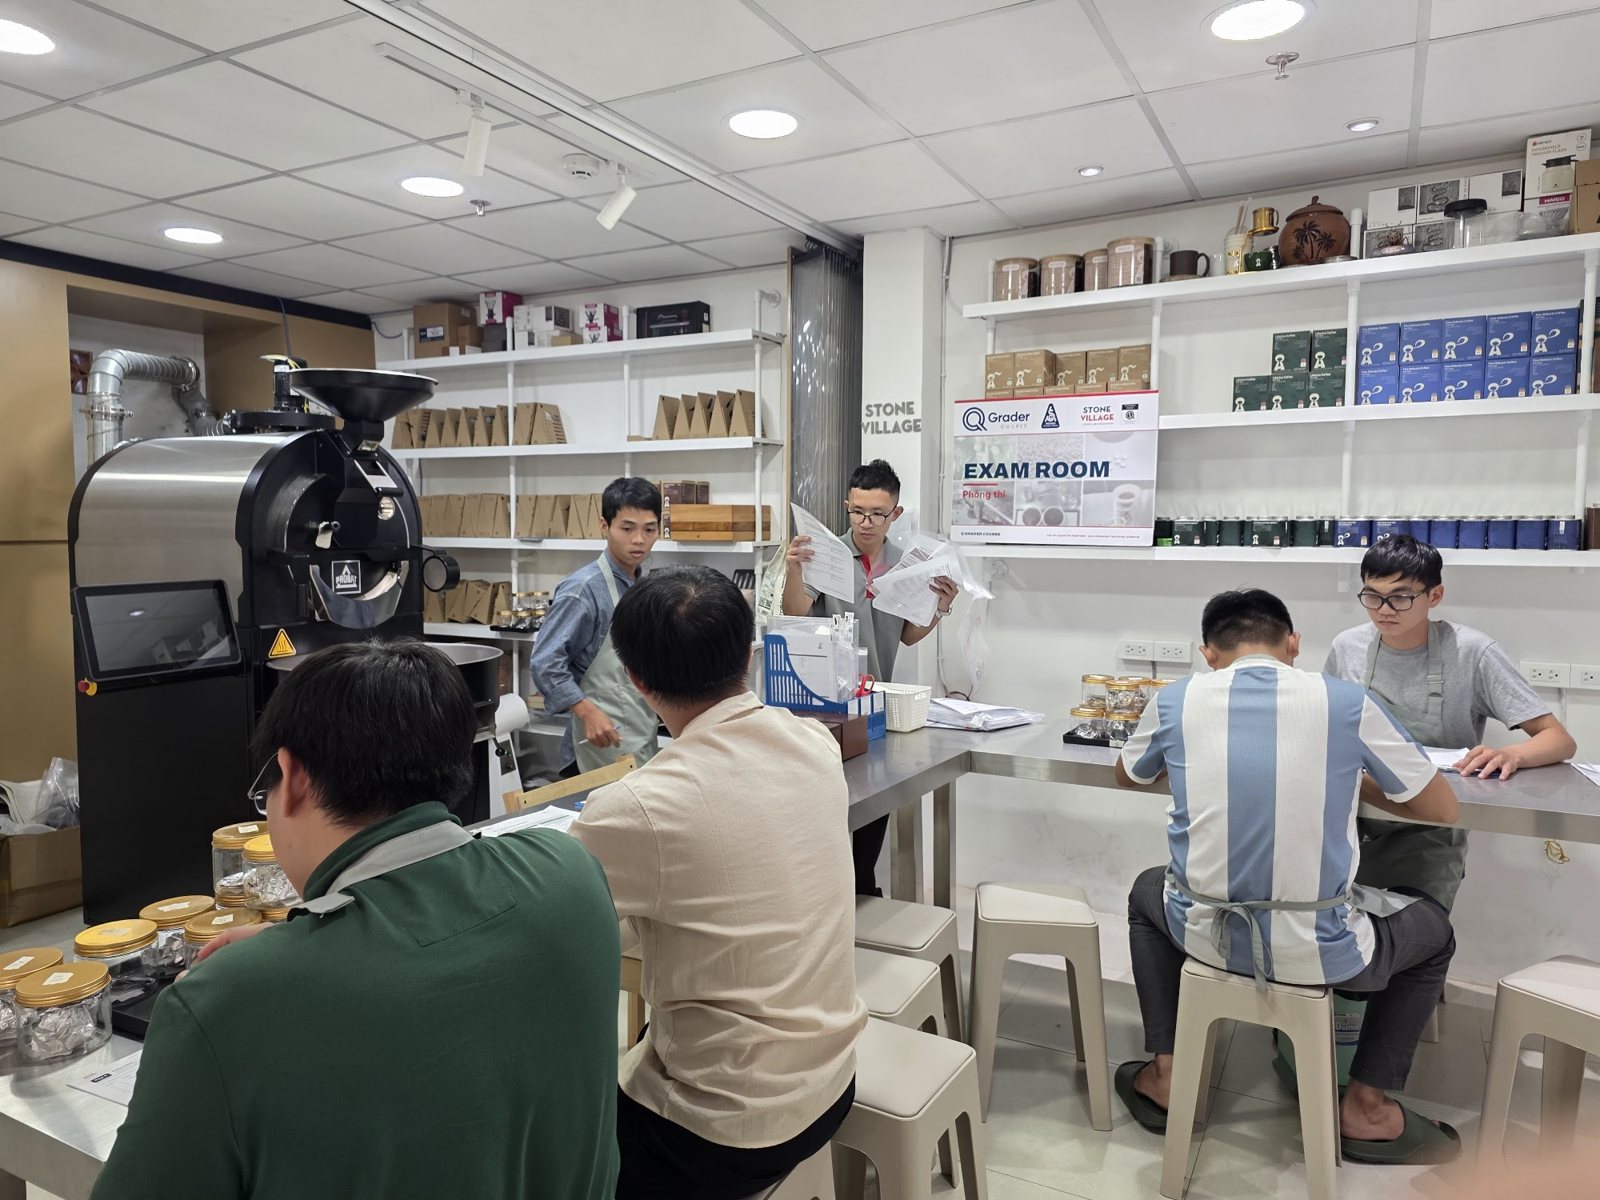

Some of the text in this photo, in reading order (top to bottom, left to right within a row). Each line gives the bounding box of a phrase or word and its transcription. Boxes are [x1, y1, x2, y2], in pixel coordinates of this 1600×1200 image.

[865, 401, 915, 418] STONE
[1082, 405, 1112, 414] STONE
[988, 411, 1030, 423] Grader
[1080, 413, 1115, 422] VILLAGE
[860, 418, 922, 435] VILLAGE
[963, 460, 1110, 479] EXAM ROOM
[962, 489, 1006, 500] Phòng thi
[336, 574, 357, 584] PROBAT
